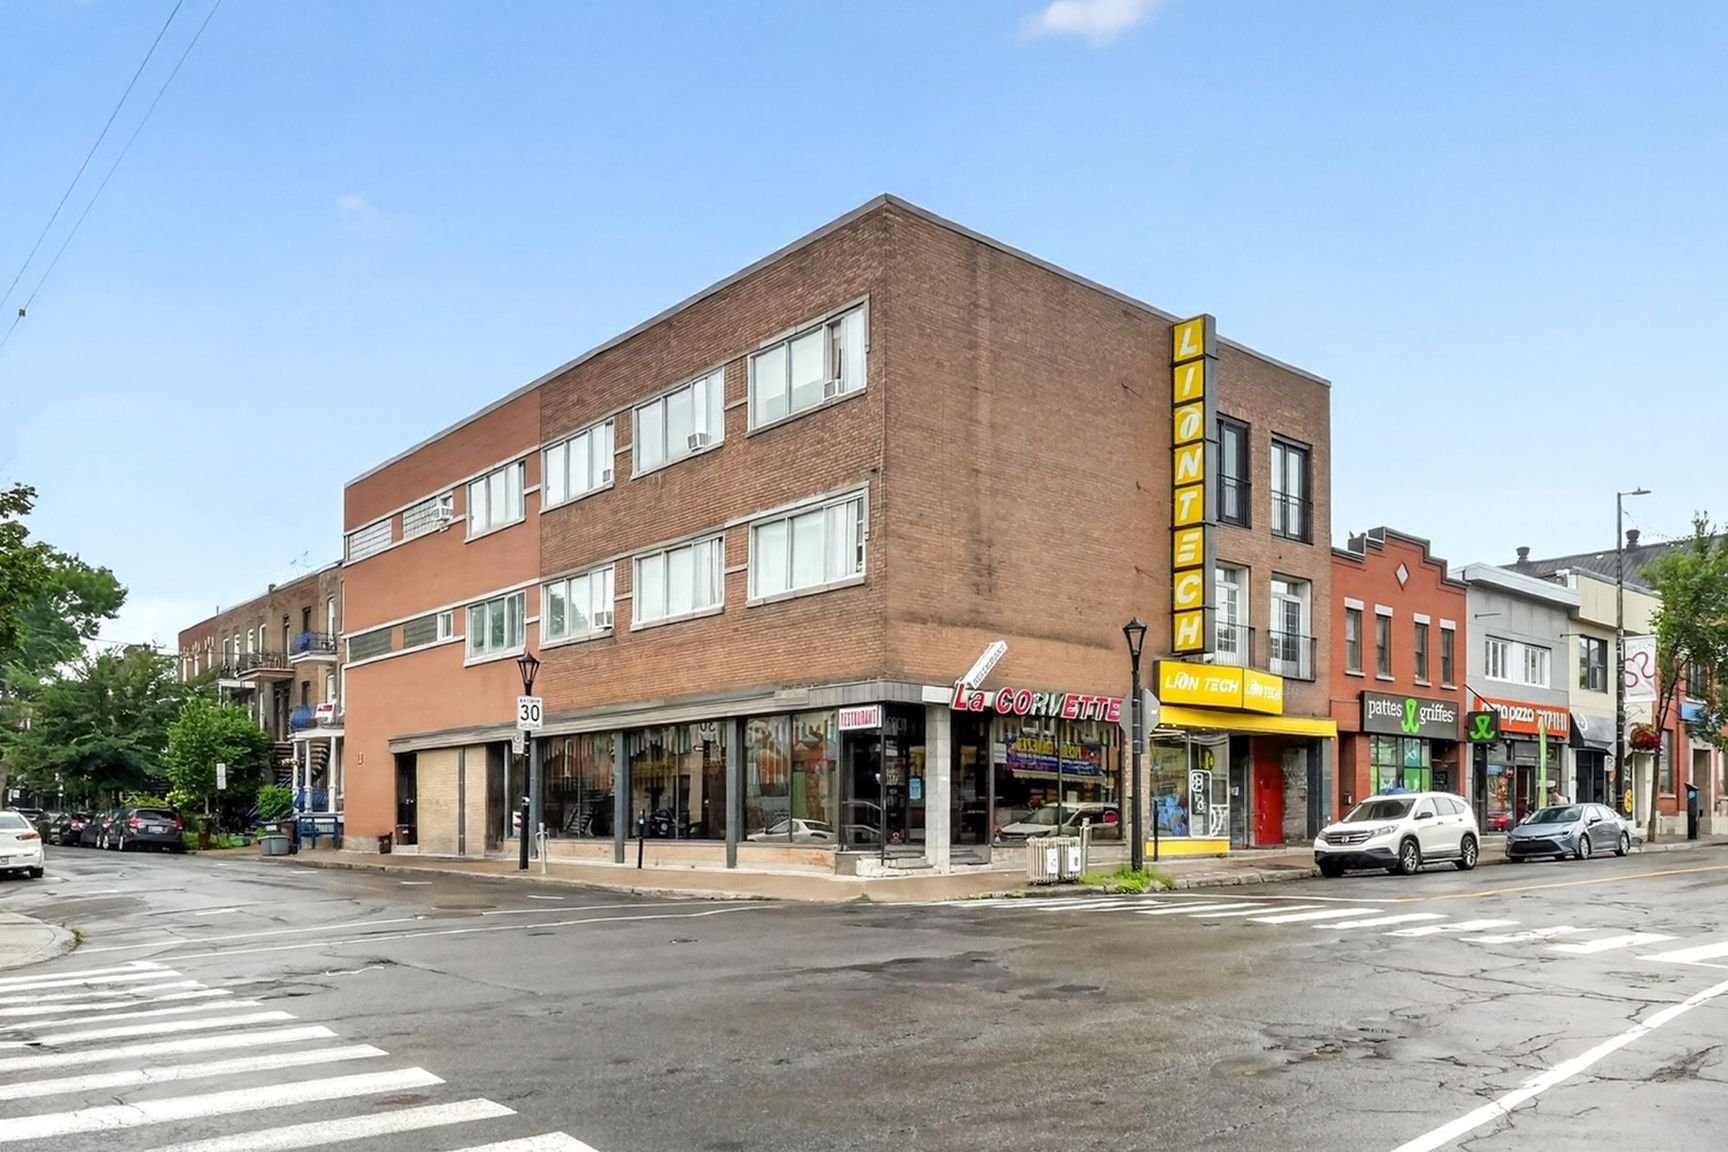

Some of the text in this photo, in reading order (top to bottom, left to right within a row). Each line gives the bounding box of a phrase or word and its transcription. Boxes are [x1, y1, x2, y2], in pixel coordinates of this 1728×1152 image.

[1165, 671, 1240, 694] LION TECH
[520, 704, 540, 722] 30
[951, 682, 1123, 723] La CORVETTE
[1368, 699, 1454, 725] pattes griffes
[1509, 705, 1535, 726] pizza
